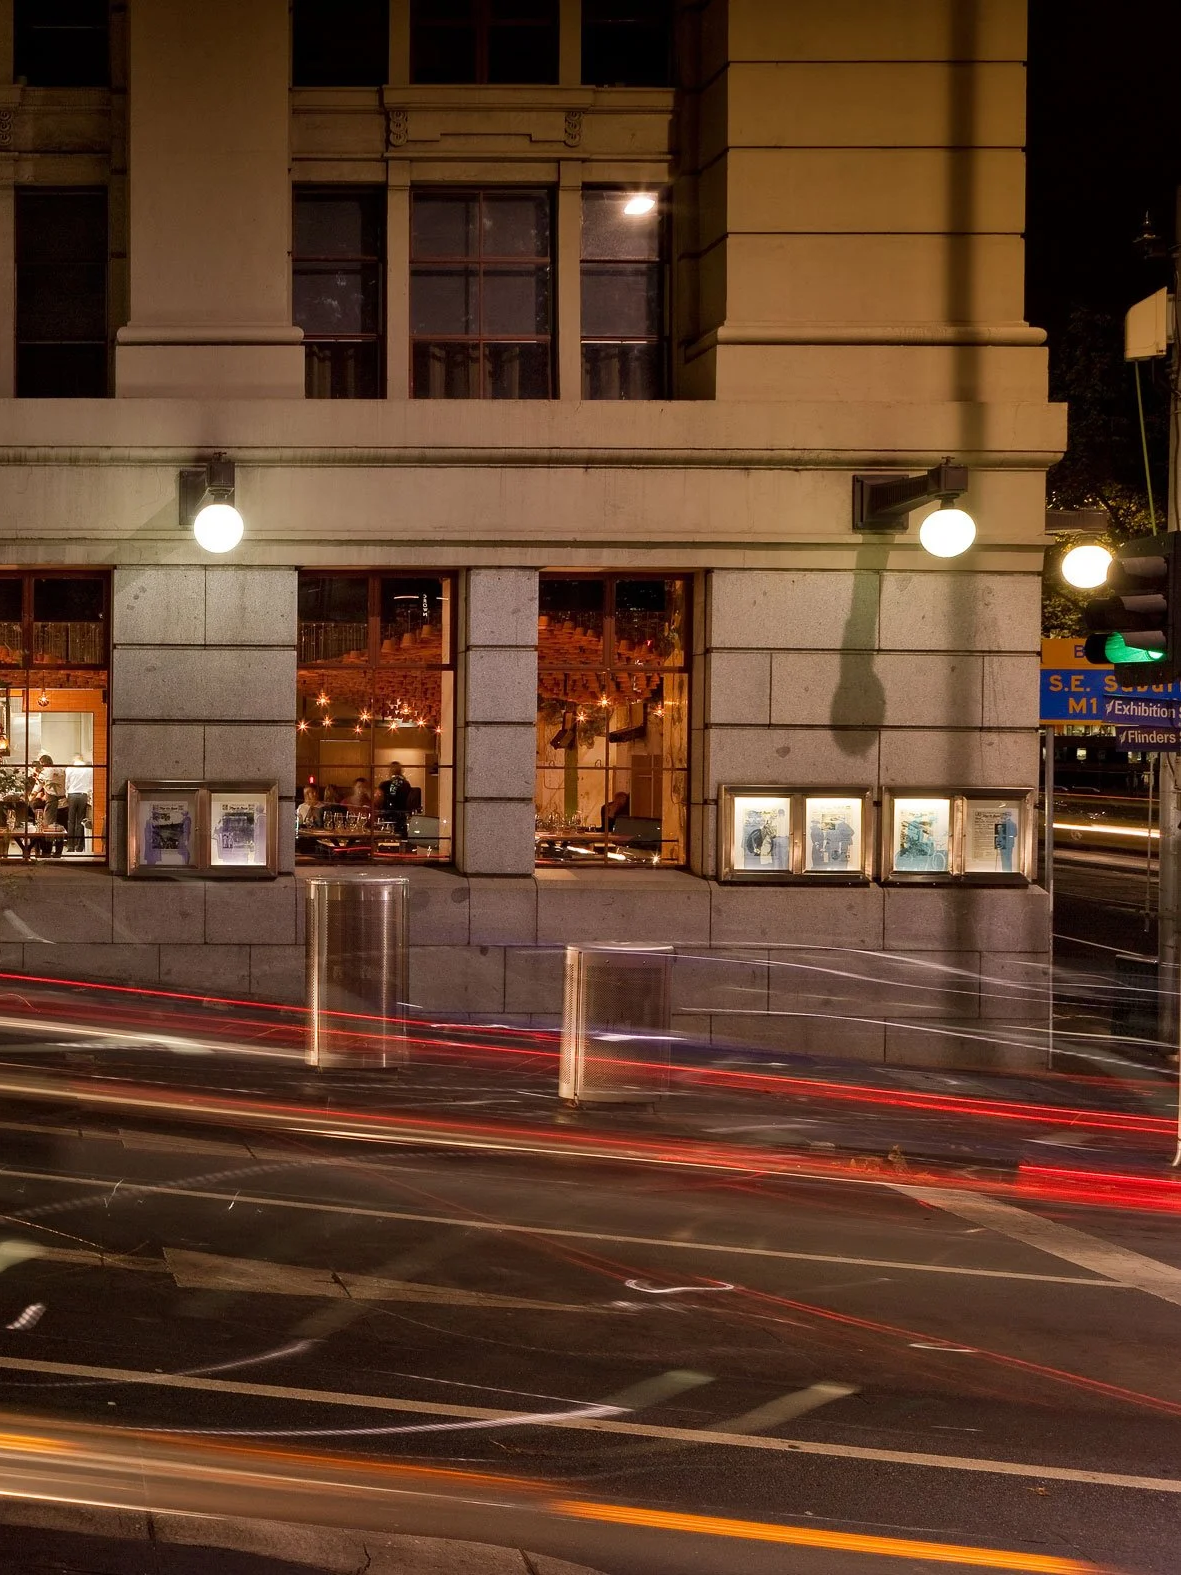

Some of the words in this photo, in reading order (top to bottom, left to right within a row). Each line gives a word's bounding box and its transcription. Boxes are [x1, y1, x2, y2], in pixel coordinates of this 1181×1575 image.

[1049, 675, 1091, 692] S.E.
[1068, 698, 1097, 714] M1
[1114, 700, 1176, 719] Exhibition
[1127, 730, 1177, 743] Flinders
